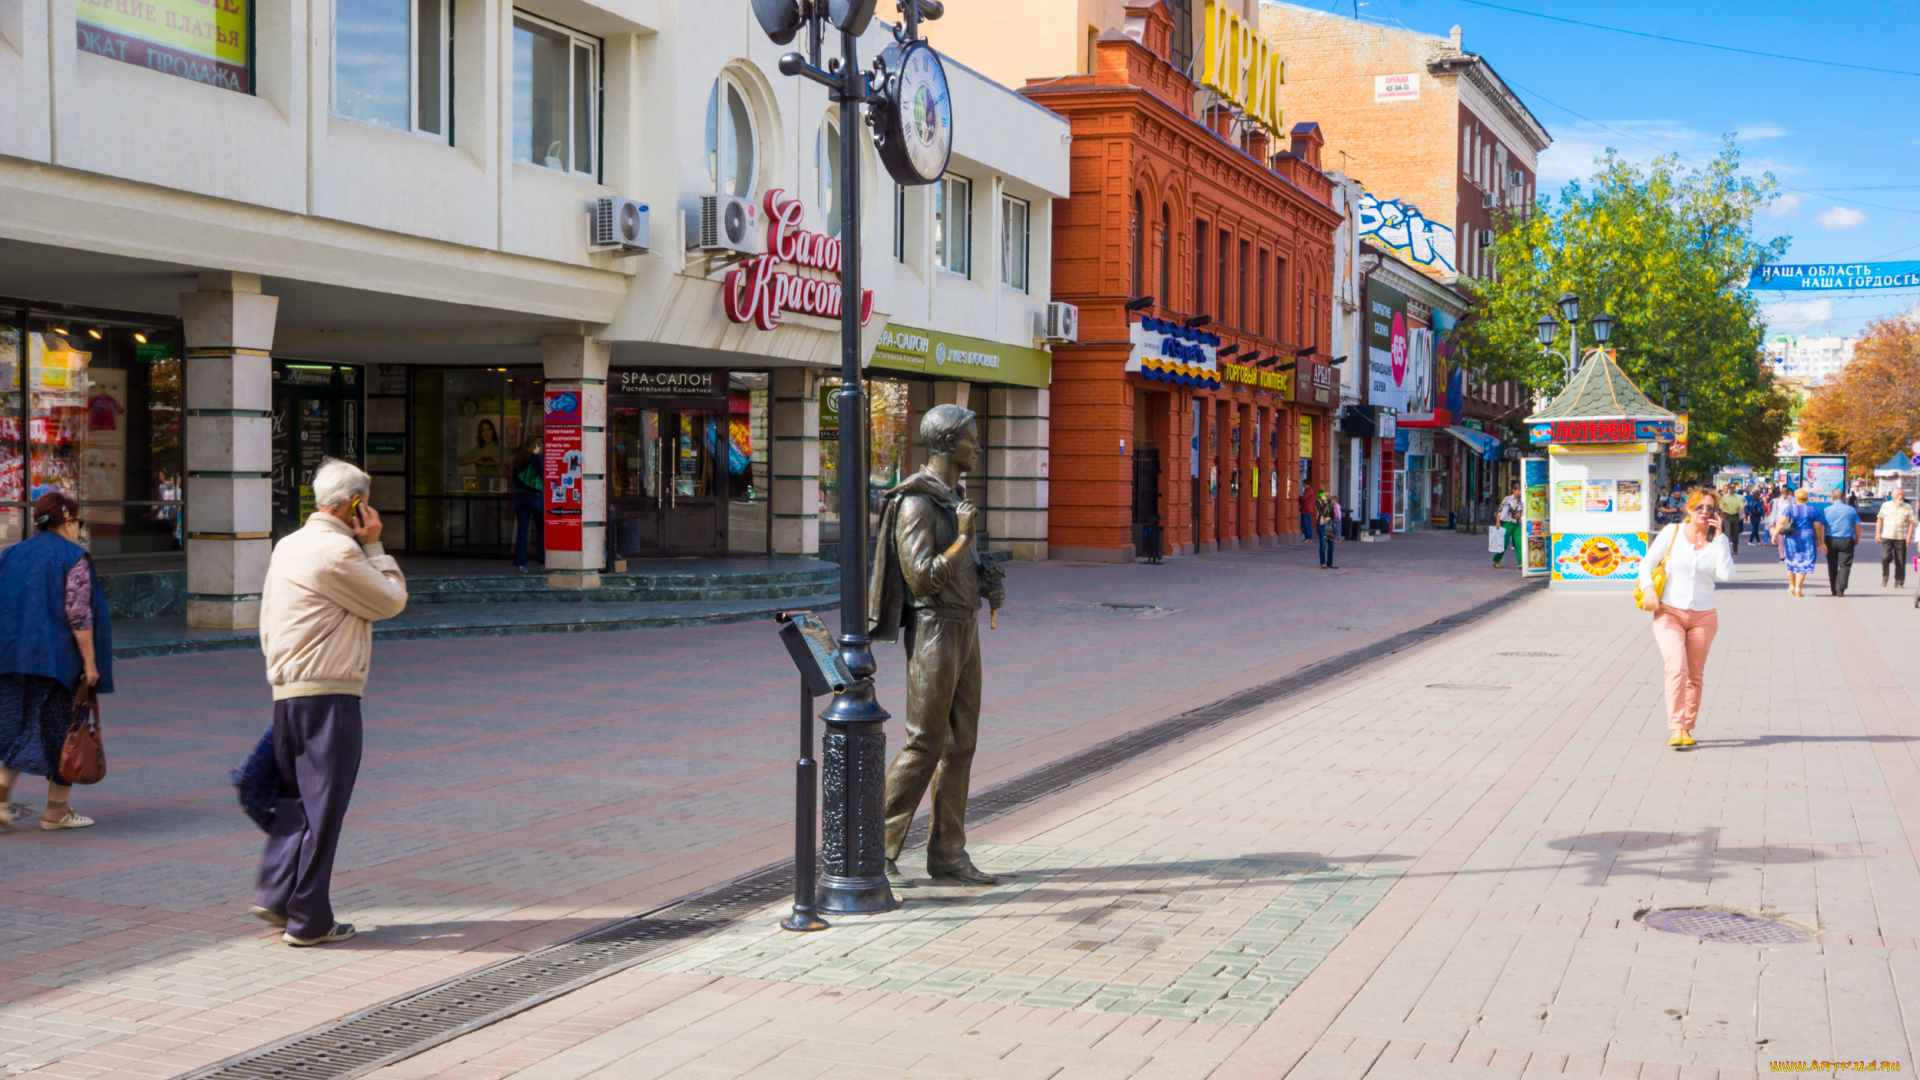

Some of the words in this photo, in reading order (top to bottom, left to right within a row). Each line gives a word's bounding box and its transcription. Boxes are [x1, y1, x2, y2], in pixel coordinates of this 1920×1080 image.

[164, 9, 241, 49] ПЛАТЬЯ
[147, 47, 241, 92] ПРОДАЖА
[1201, 0, 1288, 139] ИРИС
[763, 188, 863, 273] Сало
[1762, 266, 1804, 277] НАША
[1808, 264, 1872, 277] ОБЛАСТЬ
[1801, 277, 1844, 288] НАША
[1849, 274, 1920, 287] ГОРДОСТЬ
[947, 348, 967, 364] YVES
[968, 351, 1000, 369] ROCHER
[621, 371, 713, 387] SPA-САЛОН
[1226, 362, 1257, 386] ТОРГОВЫЙ
[1260, 370, 1287, 390] КОМПЛЕКС
[1313, 363, 1332, 385] АРБАТ
[621, 384, 671, 394] Растительной
[673, 386, 712, 394] Косметики
